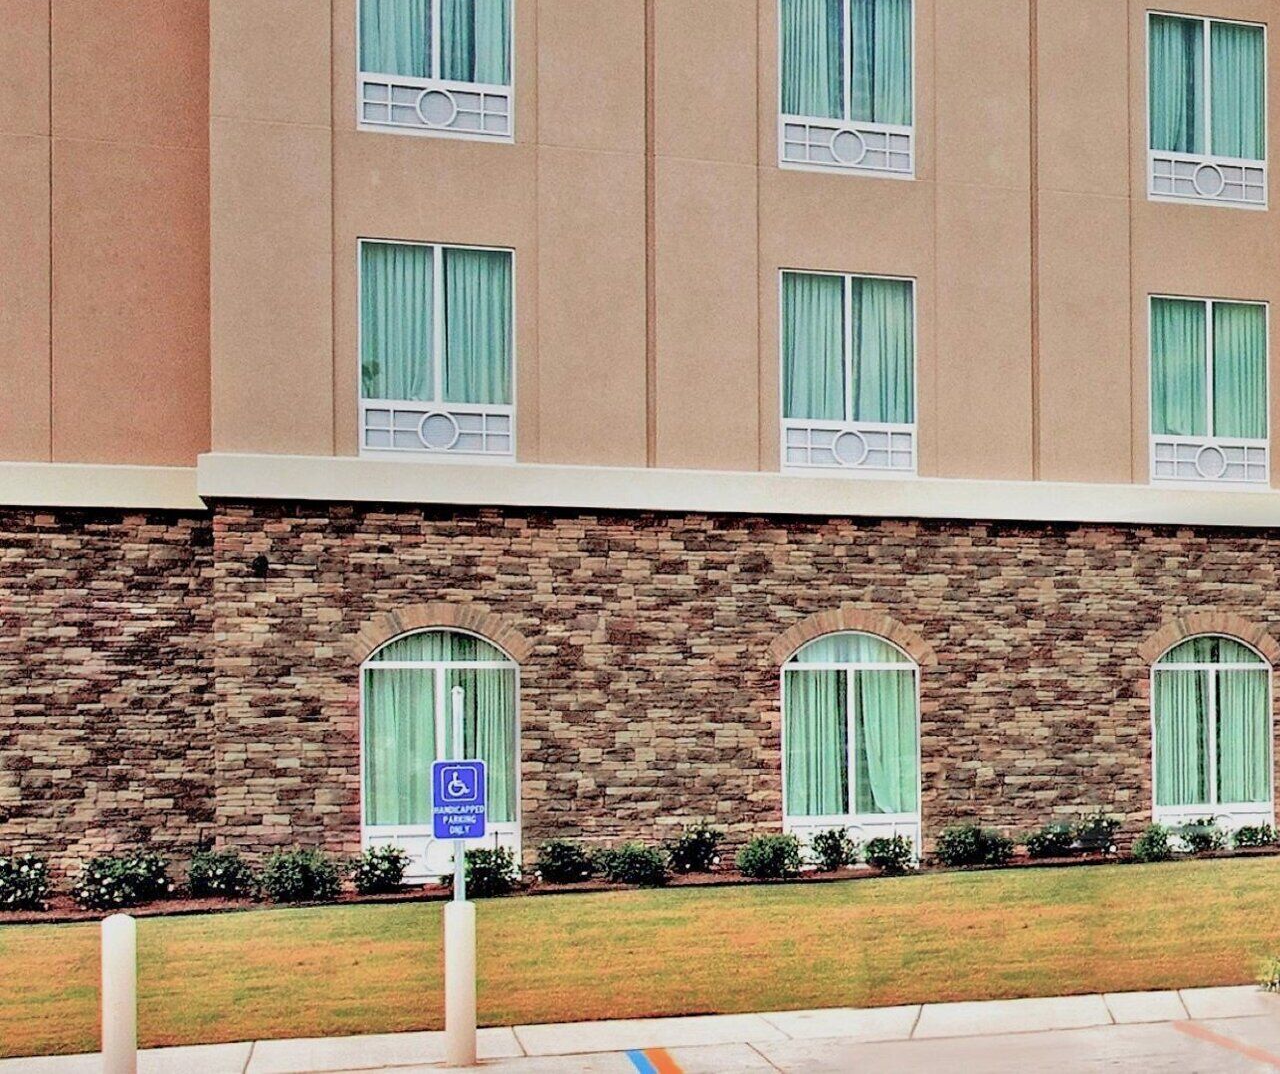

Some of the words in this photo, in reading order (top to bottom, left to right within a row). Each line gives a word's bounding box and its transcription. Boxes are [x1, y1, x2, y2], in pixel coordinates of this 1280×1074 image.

[433, 805, 485, 814] HANDICAPPED
[443, 815, 477, 825] PARKING
[449, 825, 471, 835] ONLY
